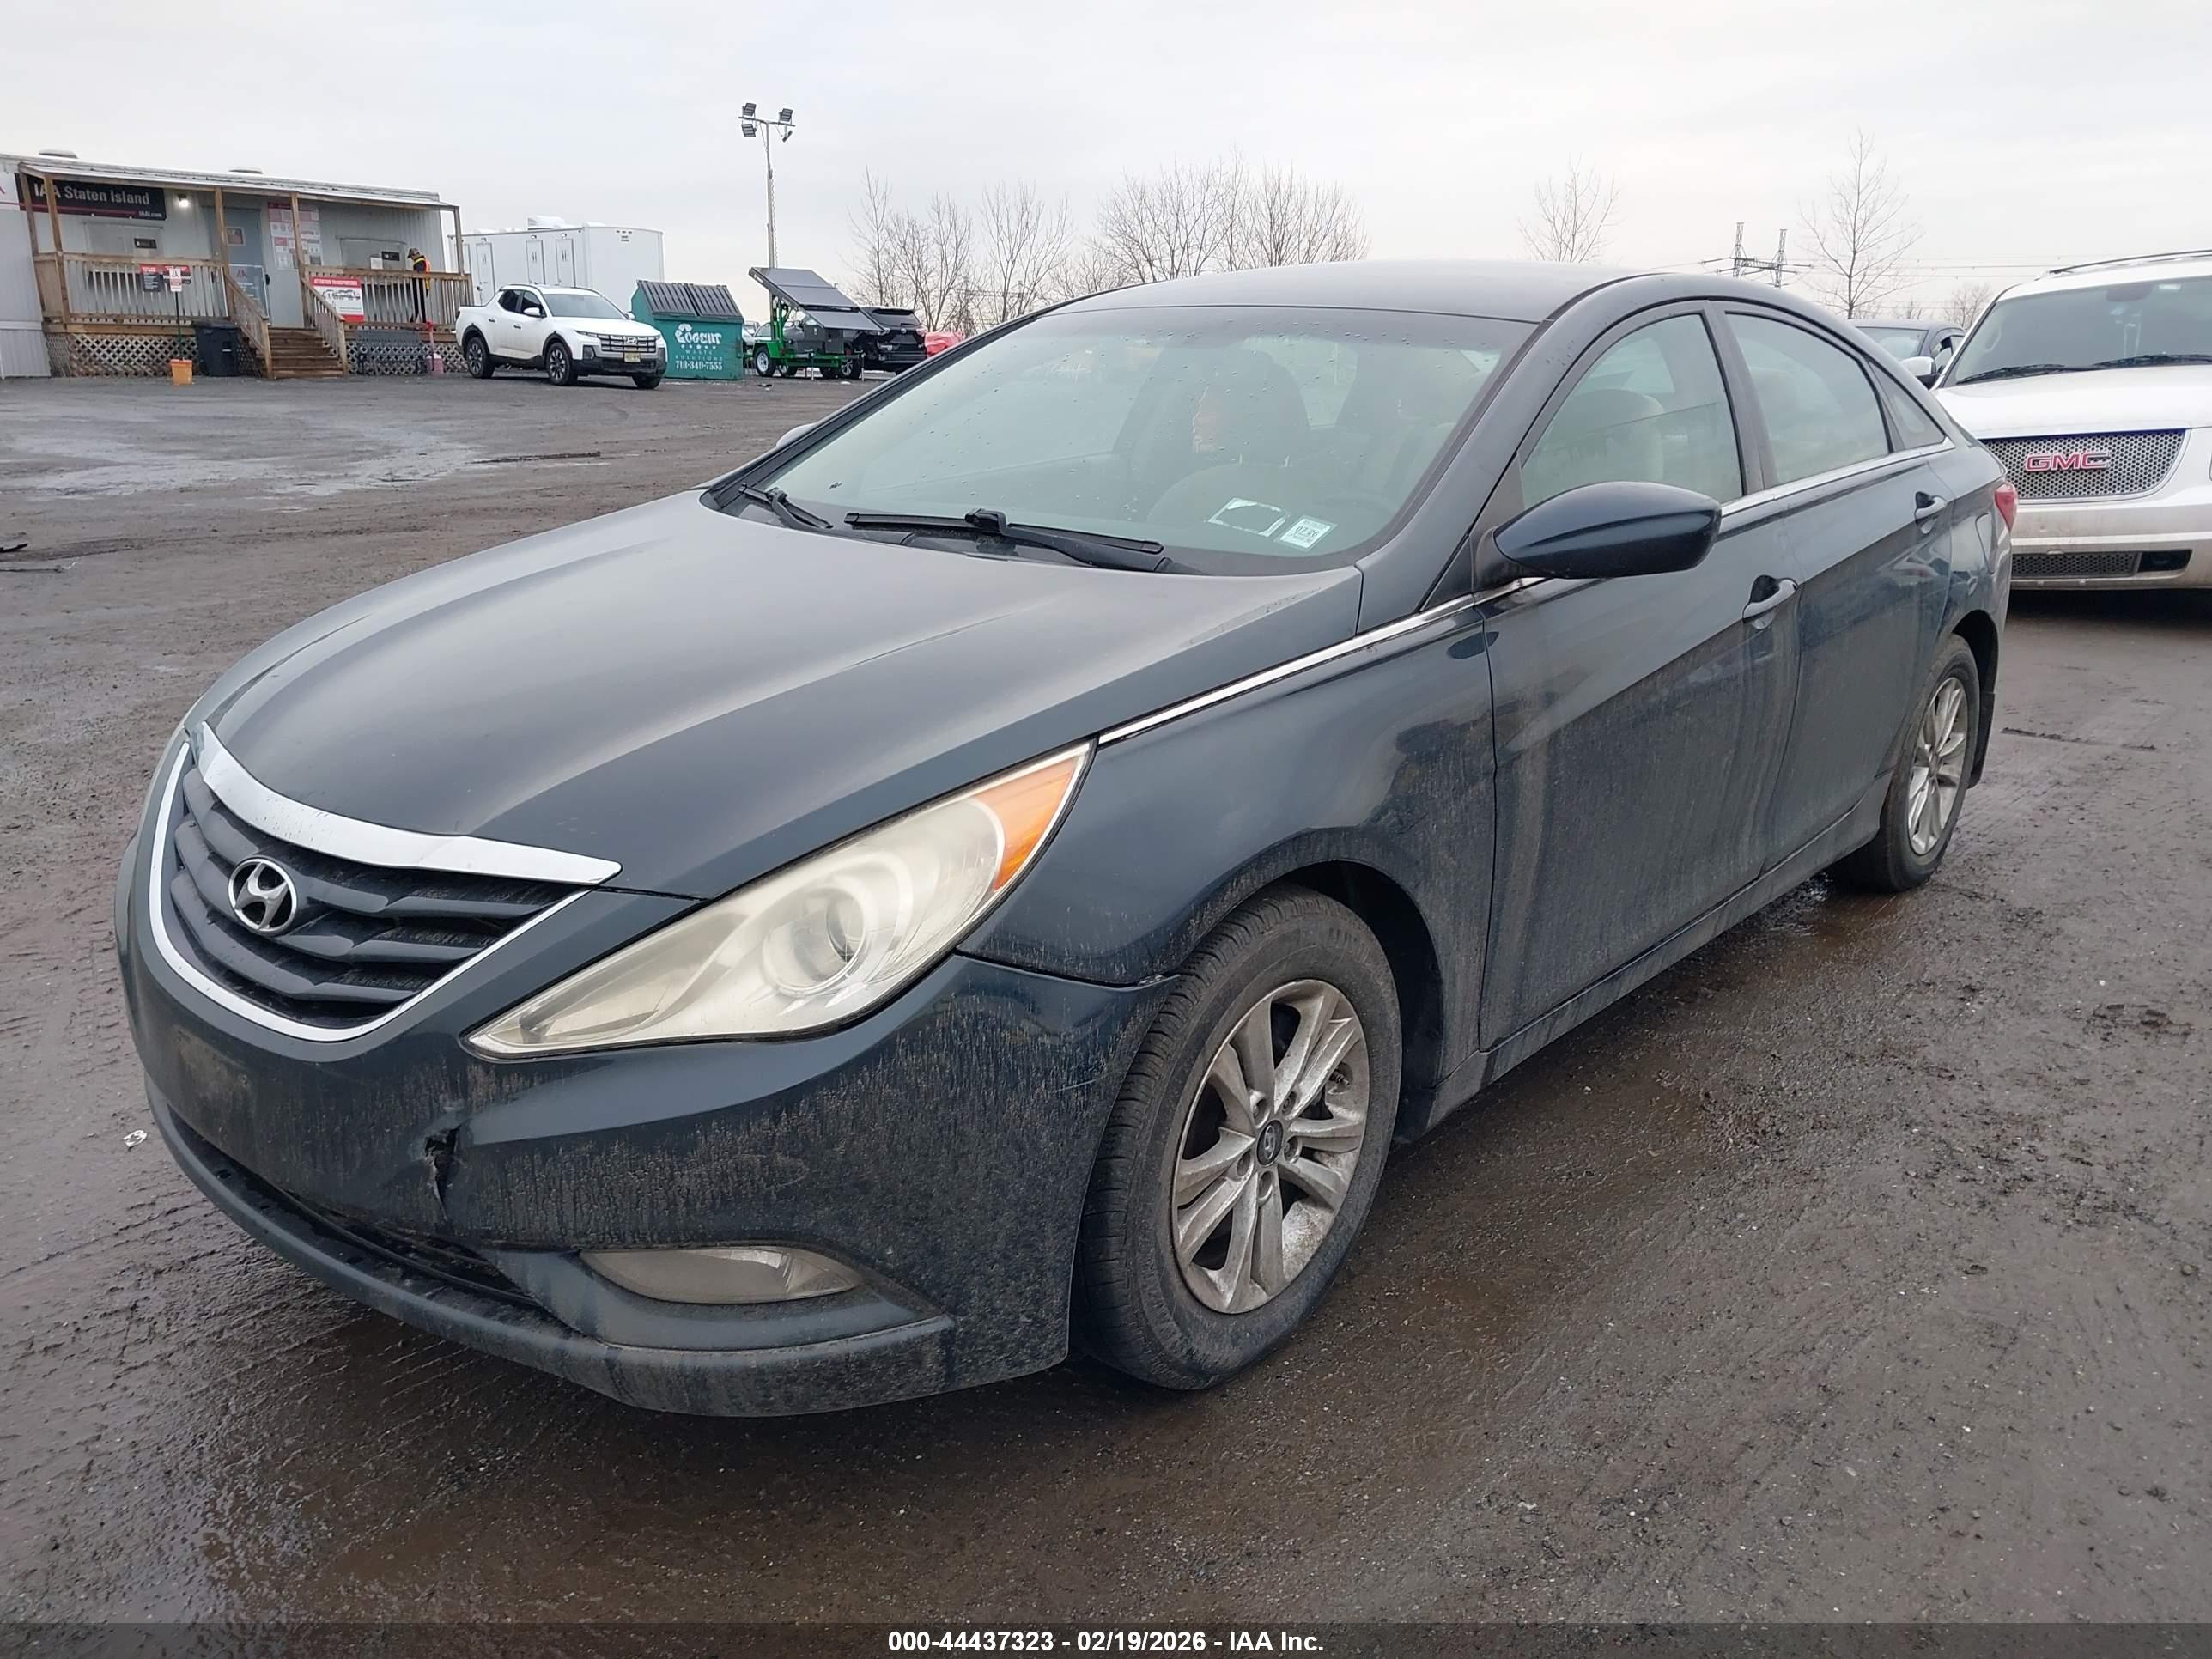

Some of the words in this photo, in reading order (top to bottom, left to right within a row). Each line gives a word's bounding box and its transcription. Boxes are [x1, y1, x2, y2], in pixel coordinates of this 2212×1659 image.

[64, 185, 106, 202] Staten
[111, 190, 150, 205] Island
[2026, 451, 2111, 471] GMC
